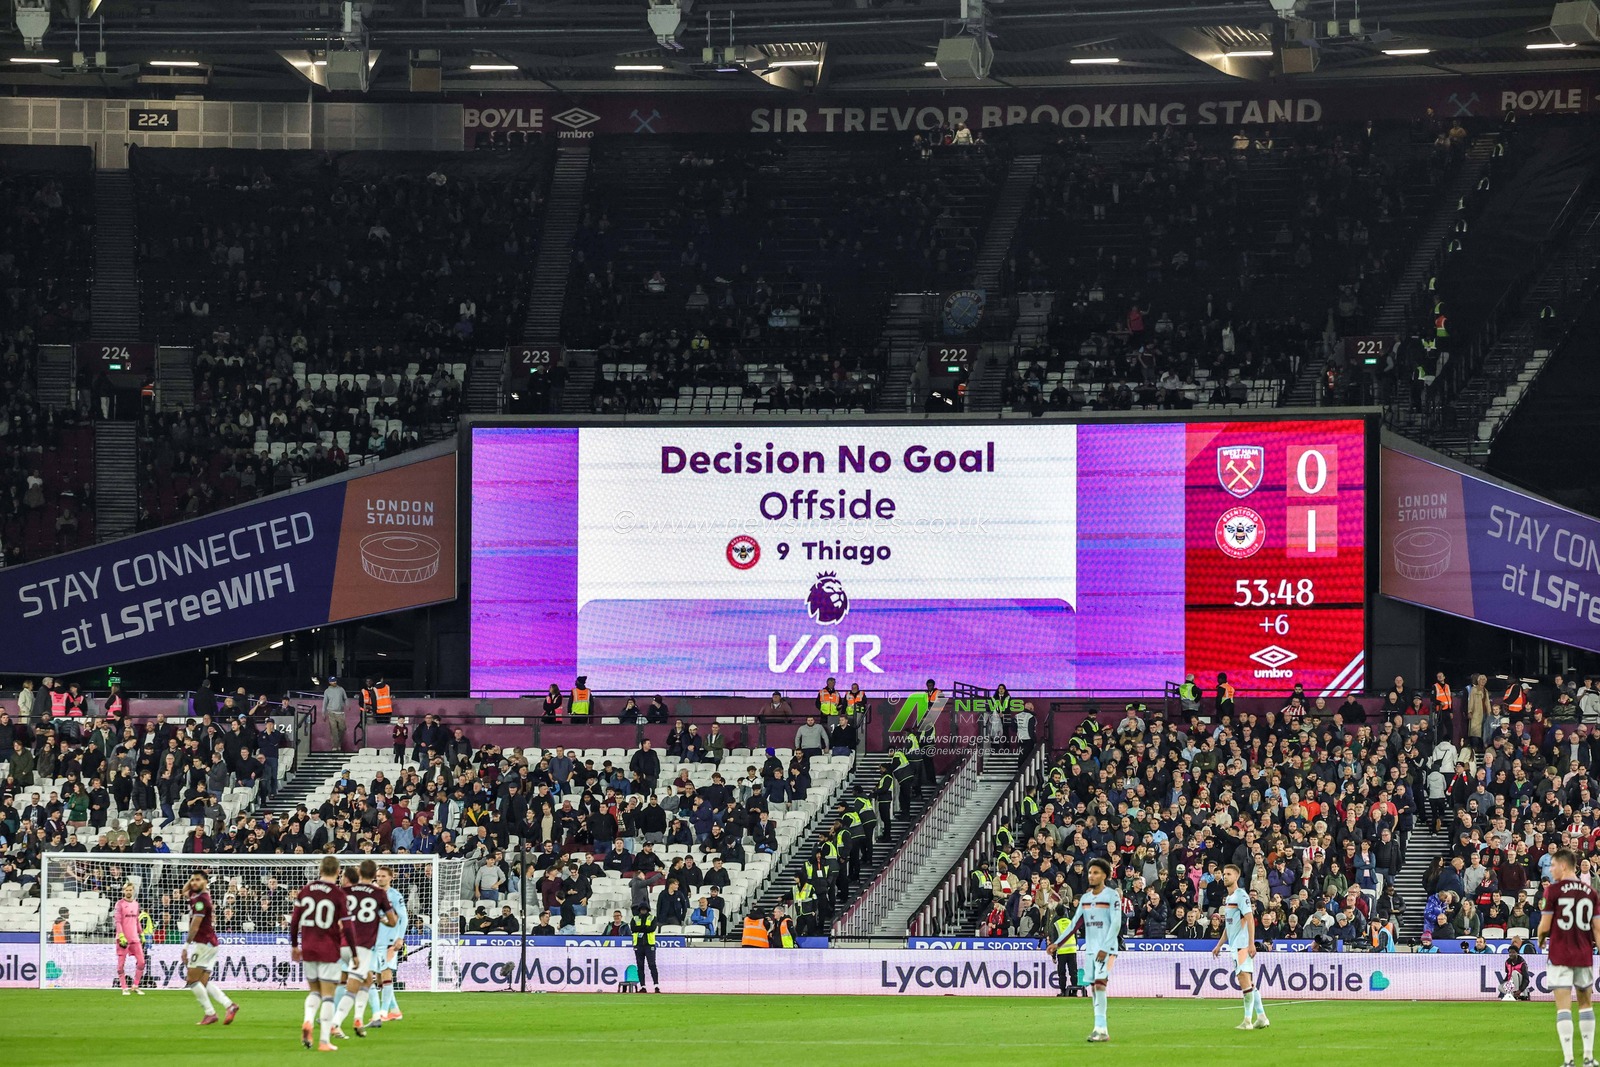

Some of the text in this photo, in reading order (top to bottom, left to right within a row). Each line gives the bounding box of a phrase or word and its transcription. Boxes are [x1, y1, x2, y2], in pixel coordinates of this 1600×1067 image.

[1501, 88, 1582, 111] BOYLE
[138, 113, 170, 127] 224
[464, 108, 543, 128] BOYLE
[750, 108, 808, 133] SIR
[818, 106, 969, 132] TREVOR
[1198, 98, 1323, 125] STAND
[556, 129, 595, 139] umbro
[101, 346, 130, 360] 224
[522, 350, 550, 364] 223
[940, 348, 968, 362] 222
[1357, 340, 1382, 354] 221
[661, 441, 995, 475] Decision No Goal
[1296, 449, 1327, 494] 0
[367, 498, 434, 513] LONDON
[759, 488, 896, 521] Offside
[1398, 493, 1448, 508] LONDON
[367, 512, 434, 526] STADIUM
[1398, 507, 1448, 522] STADIUM
[1486, 504, 1551, 553] STAY
[776, 541, 892, 566] 9 Thiago
[18, 511, 315, 618] STAY CONNECTED
[1502, 563, 1528, 596] at
[1234, 578, 1315, 607] 53:48
[61, 562, 296, 655] at LSFreeWIFI
[1259, 614, 1290, 635] +6
[768, 634, 884, 673] VAR
[1253, 668, 1293, 679] umbro
[274, 723, 293, 734] 24
[300, 896, 336, 930] 20
[1557, 897, 1594, 931] 30
[988, 941, 1034, 950] SPORTS
[1138, 942, 1185, 951] SPORTS
[881, 961, 1060, 993] LycaMobile
